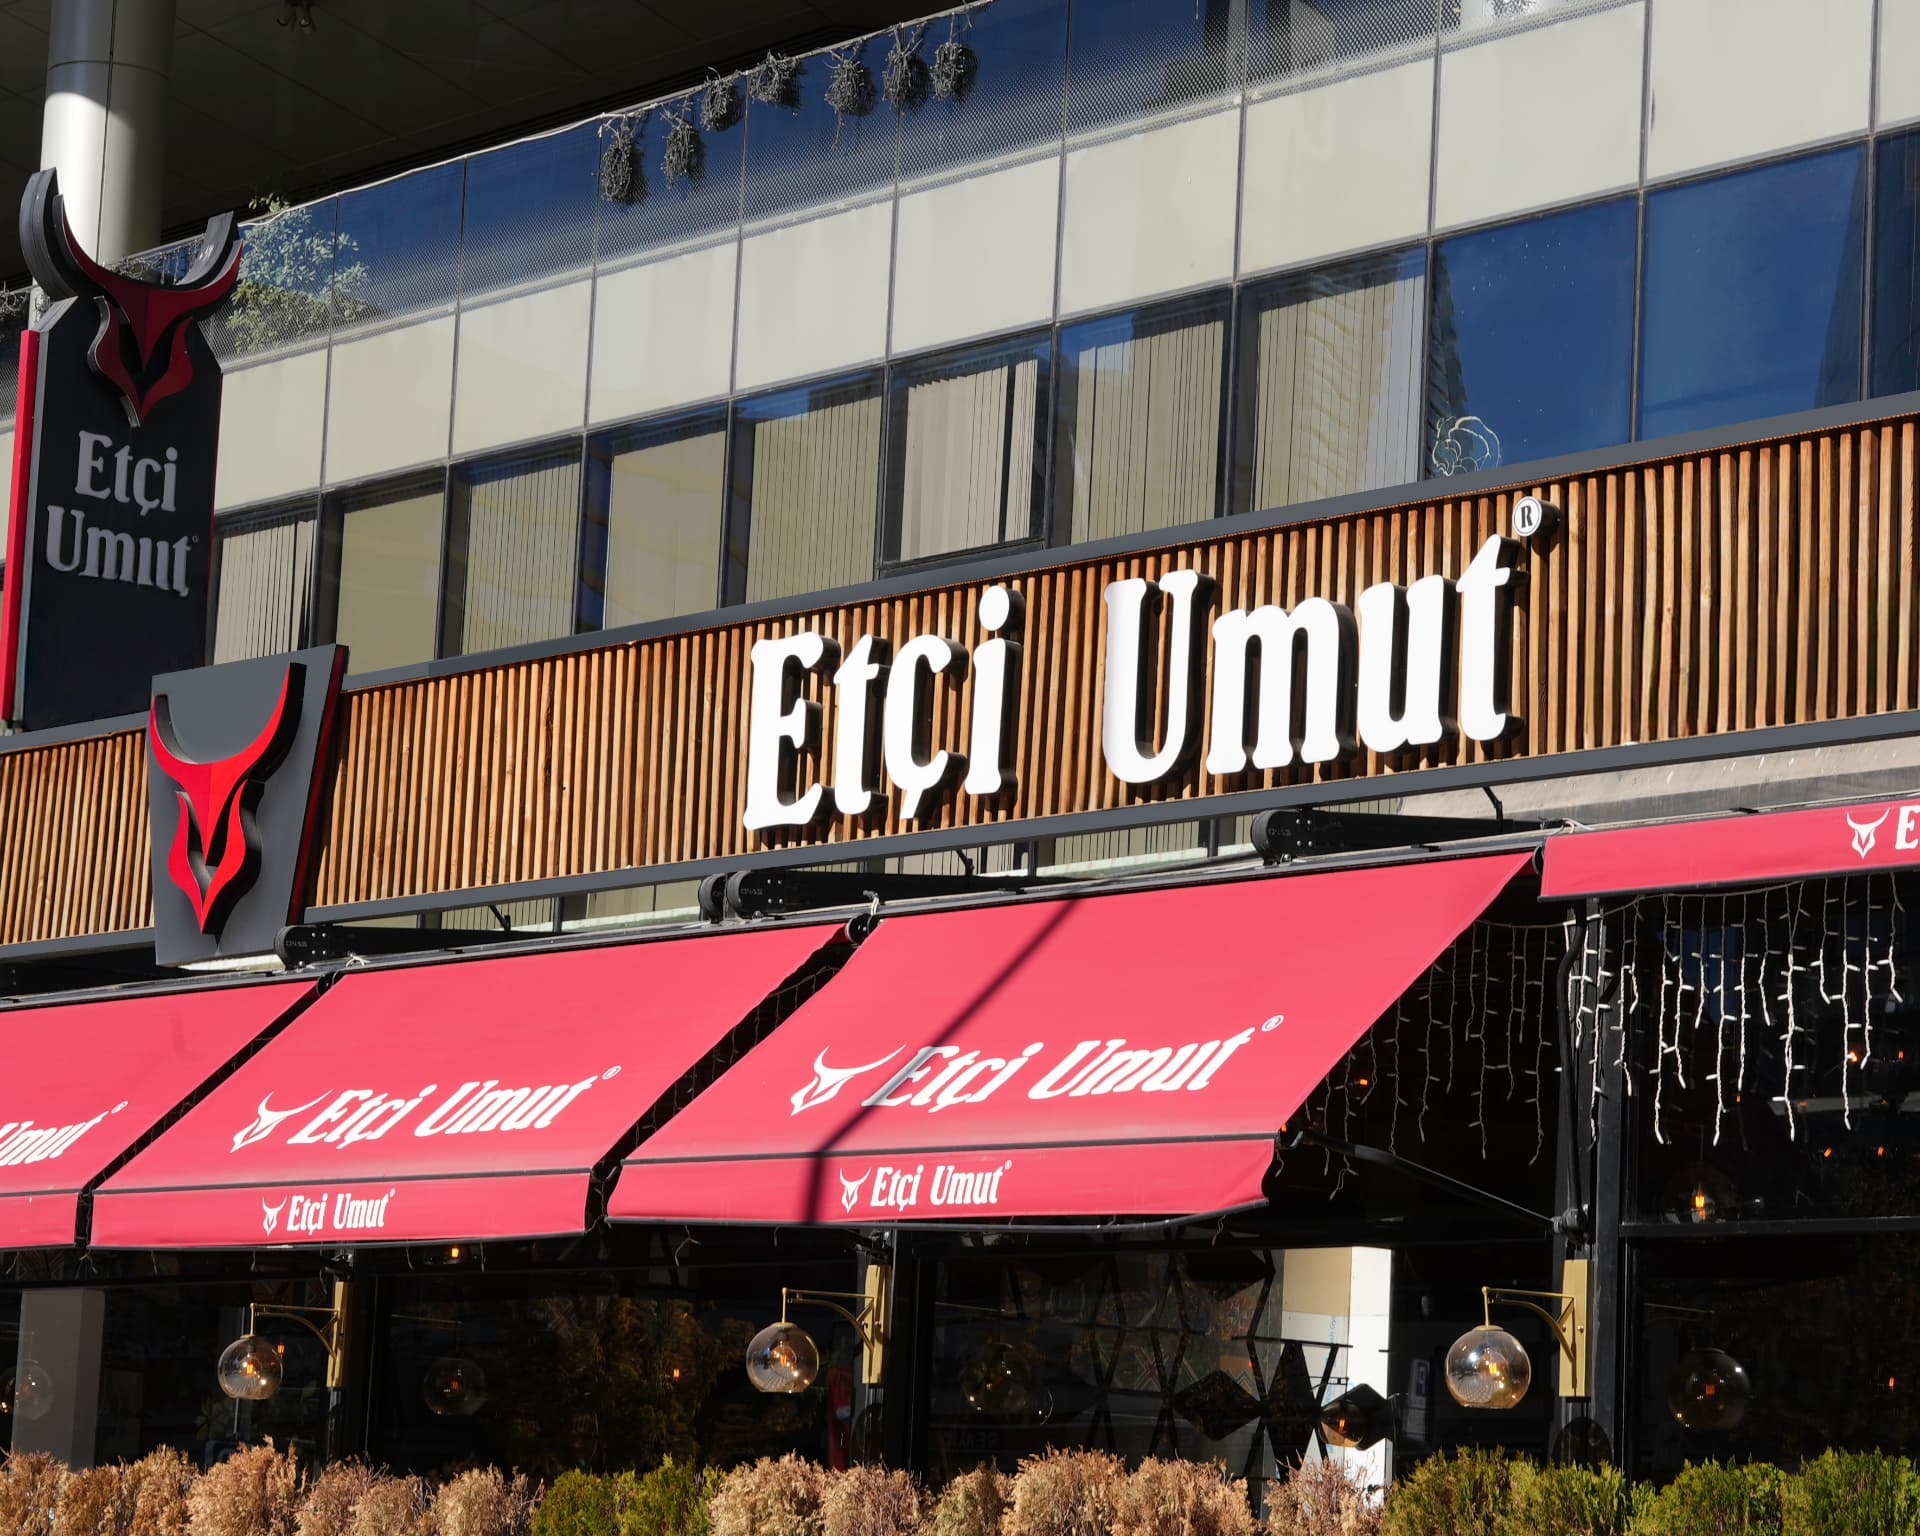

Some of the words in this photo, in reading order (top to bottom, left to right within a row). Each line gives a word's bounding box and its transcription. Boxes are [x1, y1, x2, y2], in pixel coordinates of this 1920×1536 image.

[74, 430, 178, 516] Etçi
[46, 504, 191, 597] Umut
[742, 585, 1010, 831] Etçi
[1103, 534, 1511, 784] Umut
[286, 1083, 438, 1150] Etçi
[414, 1075, 598, 1137] Umut
[860, 1042, 1045, 1113] Etçi
[1027, 1026, 1256, 1099] Umut
[286, 1190, 329, 1236] Etçi
[333, 1192, 389, 1230] Umut
[869, 1164, 925, 1212] Etçi
[929, 1163, 1004, 1206] Umut
